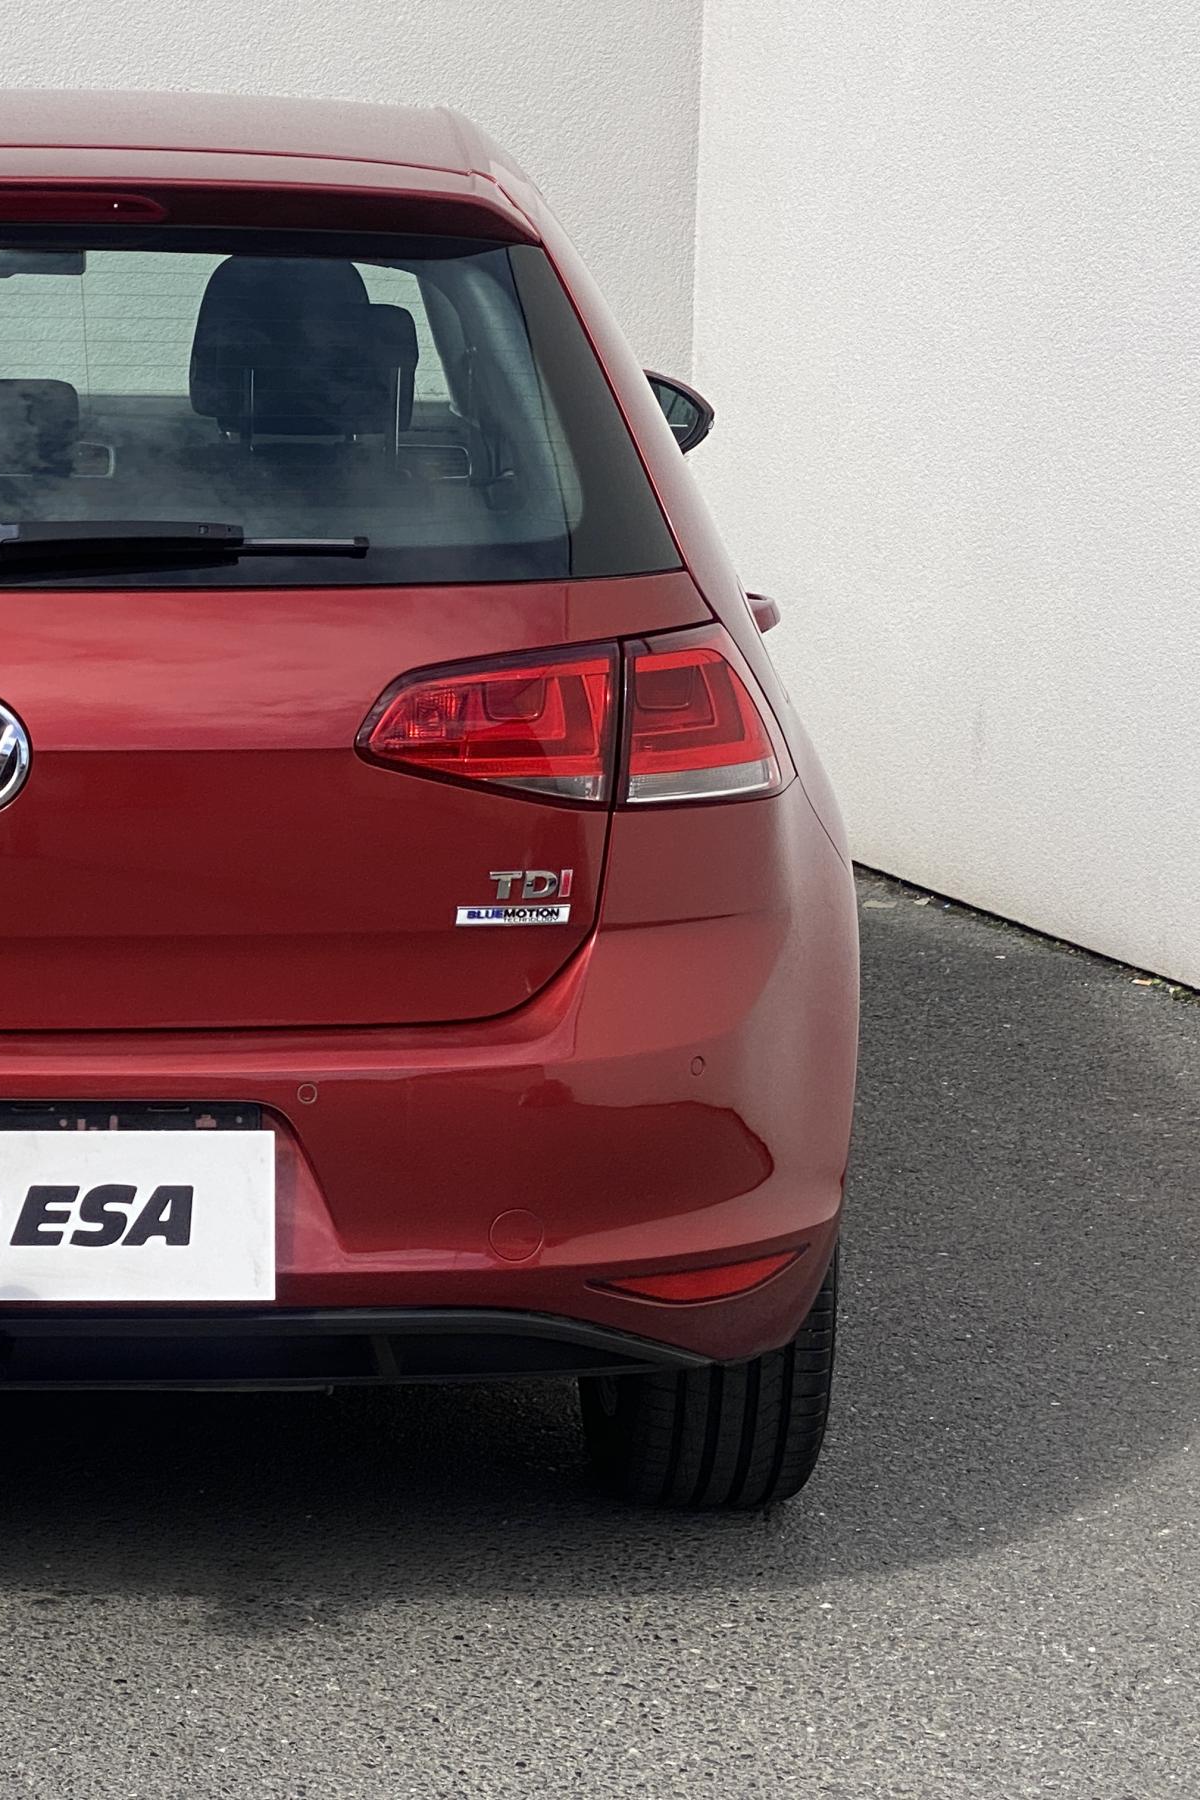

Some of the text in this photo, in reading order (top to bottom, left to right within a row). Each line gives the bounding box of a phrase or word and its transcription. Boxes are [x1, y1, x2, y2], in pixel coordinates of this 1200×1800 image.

[489, 869, 574, 899] TDI
[466, 908, 560, 919] BLUEMOTION
[9, 1184, 194, 1247] ESA
